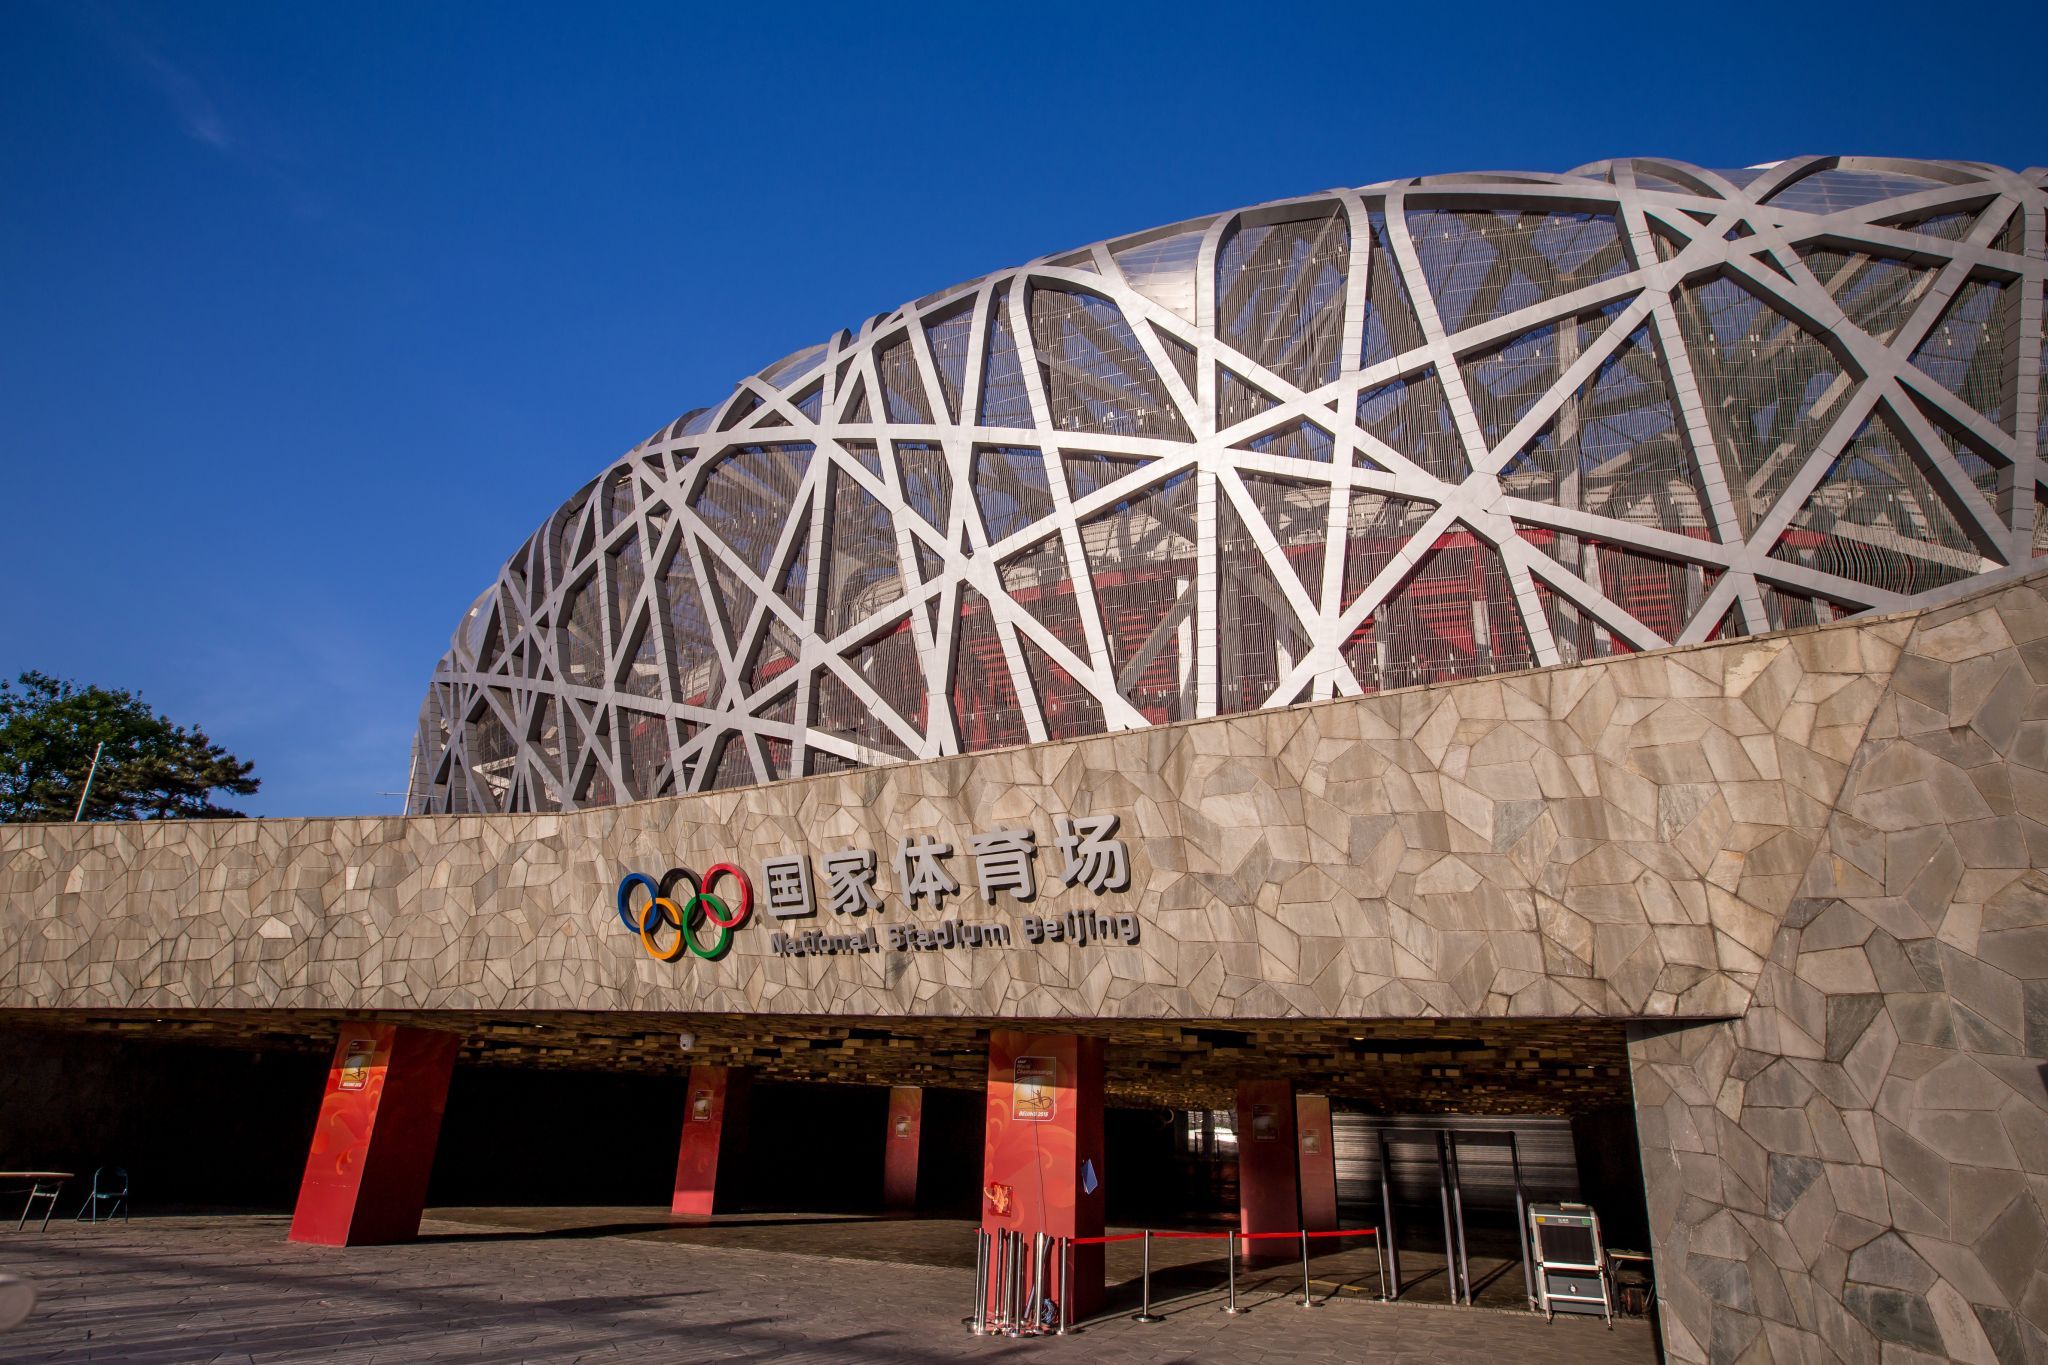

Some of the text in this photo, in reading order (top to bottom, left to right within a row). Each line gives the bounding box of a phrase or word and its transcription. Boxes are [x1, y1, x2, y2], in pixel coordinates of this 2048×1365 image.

[761, 814, 1131, 917] 国家体育场
[771, 908, 1140, 955] National Stadium Beijing
